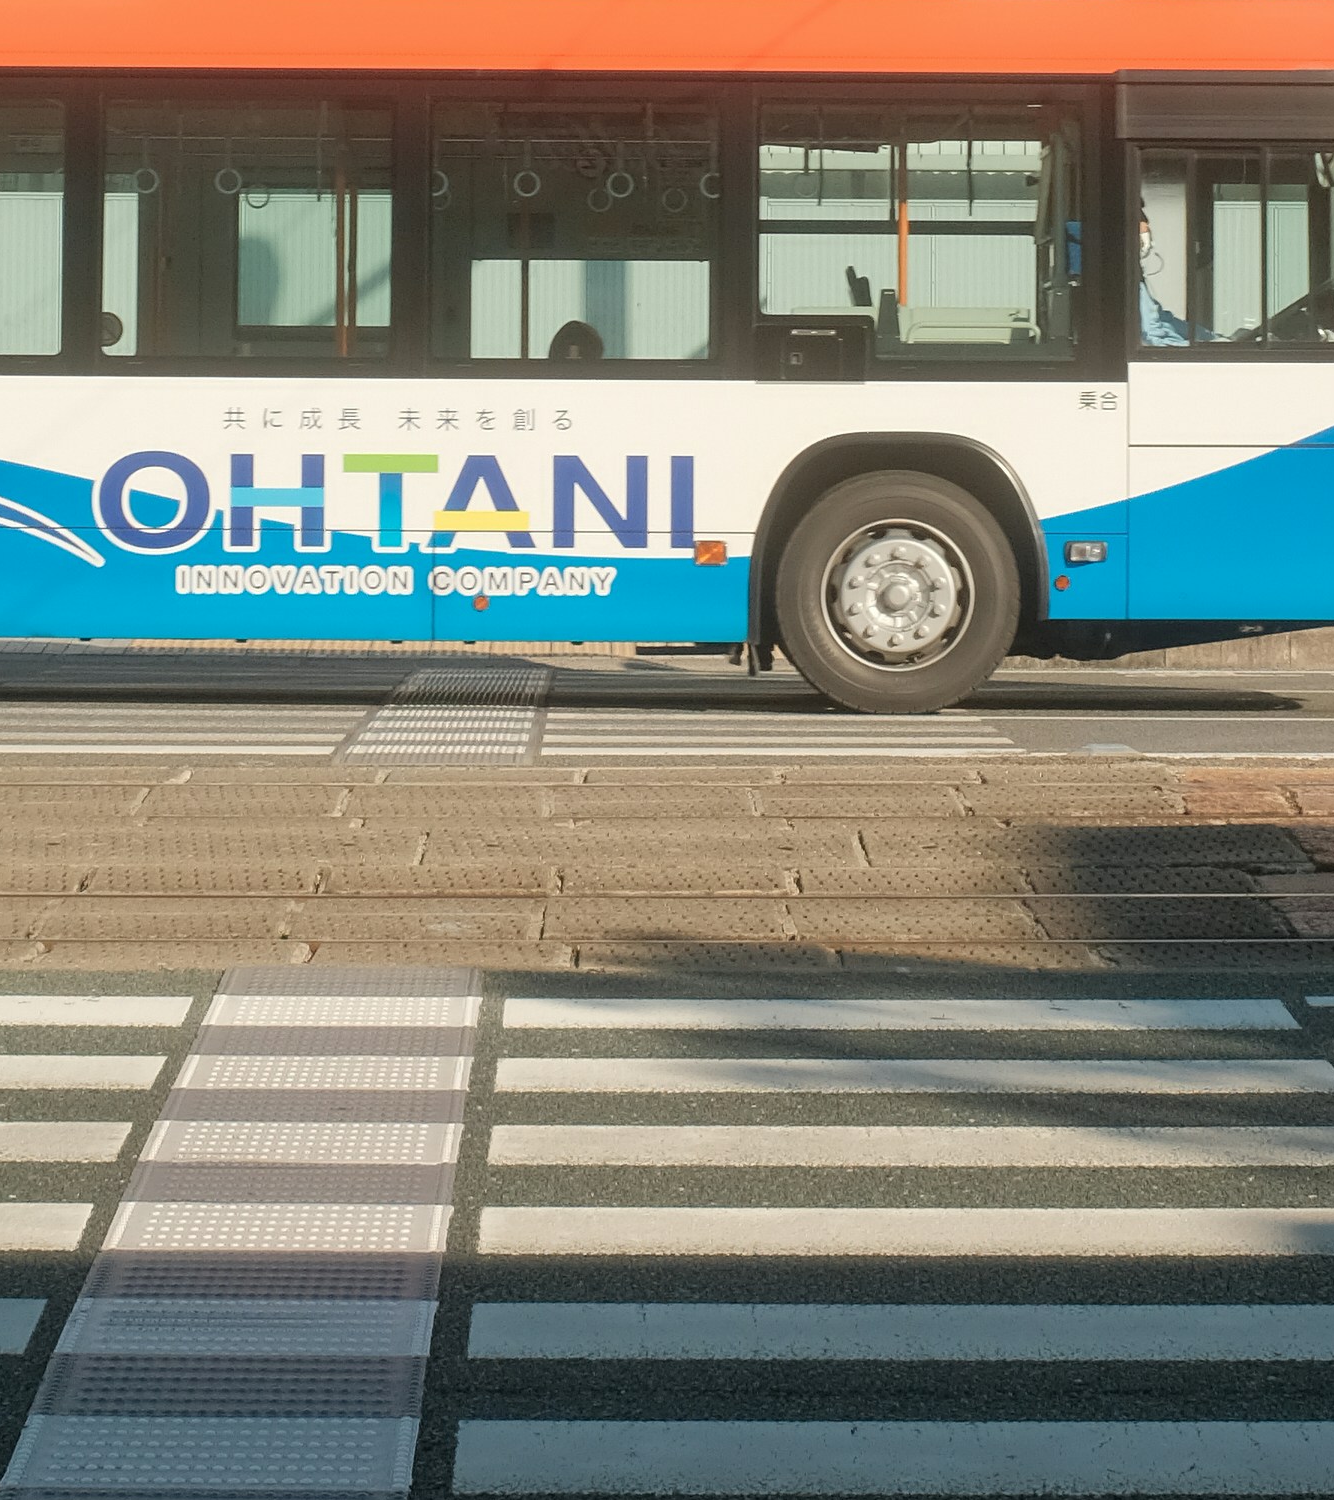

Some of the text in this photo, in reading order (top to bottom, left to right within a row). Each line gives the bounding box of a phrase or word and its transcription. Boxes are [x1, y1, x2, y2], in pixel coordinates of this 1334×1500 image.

[1078, 391, 1118, 410] 乗合
[223, 407, 573, 431] 共に成長 未来を創る
[99, 450, 694, 549] OHTANI
[179, 569, 614, 593] INNOVATION COMPANY
